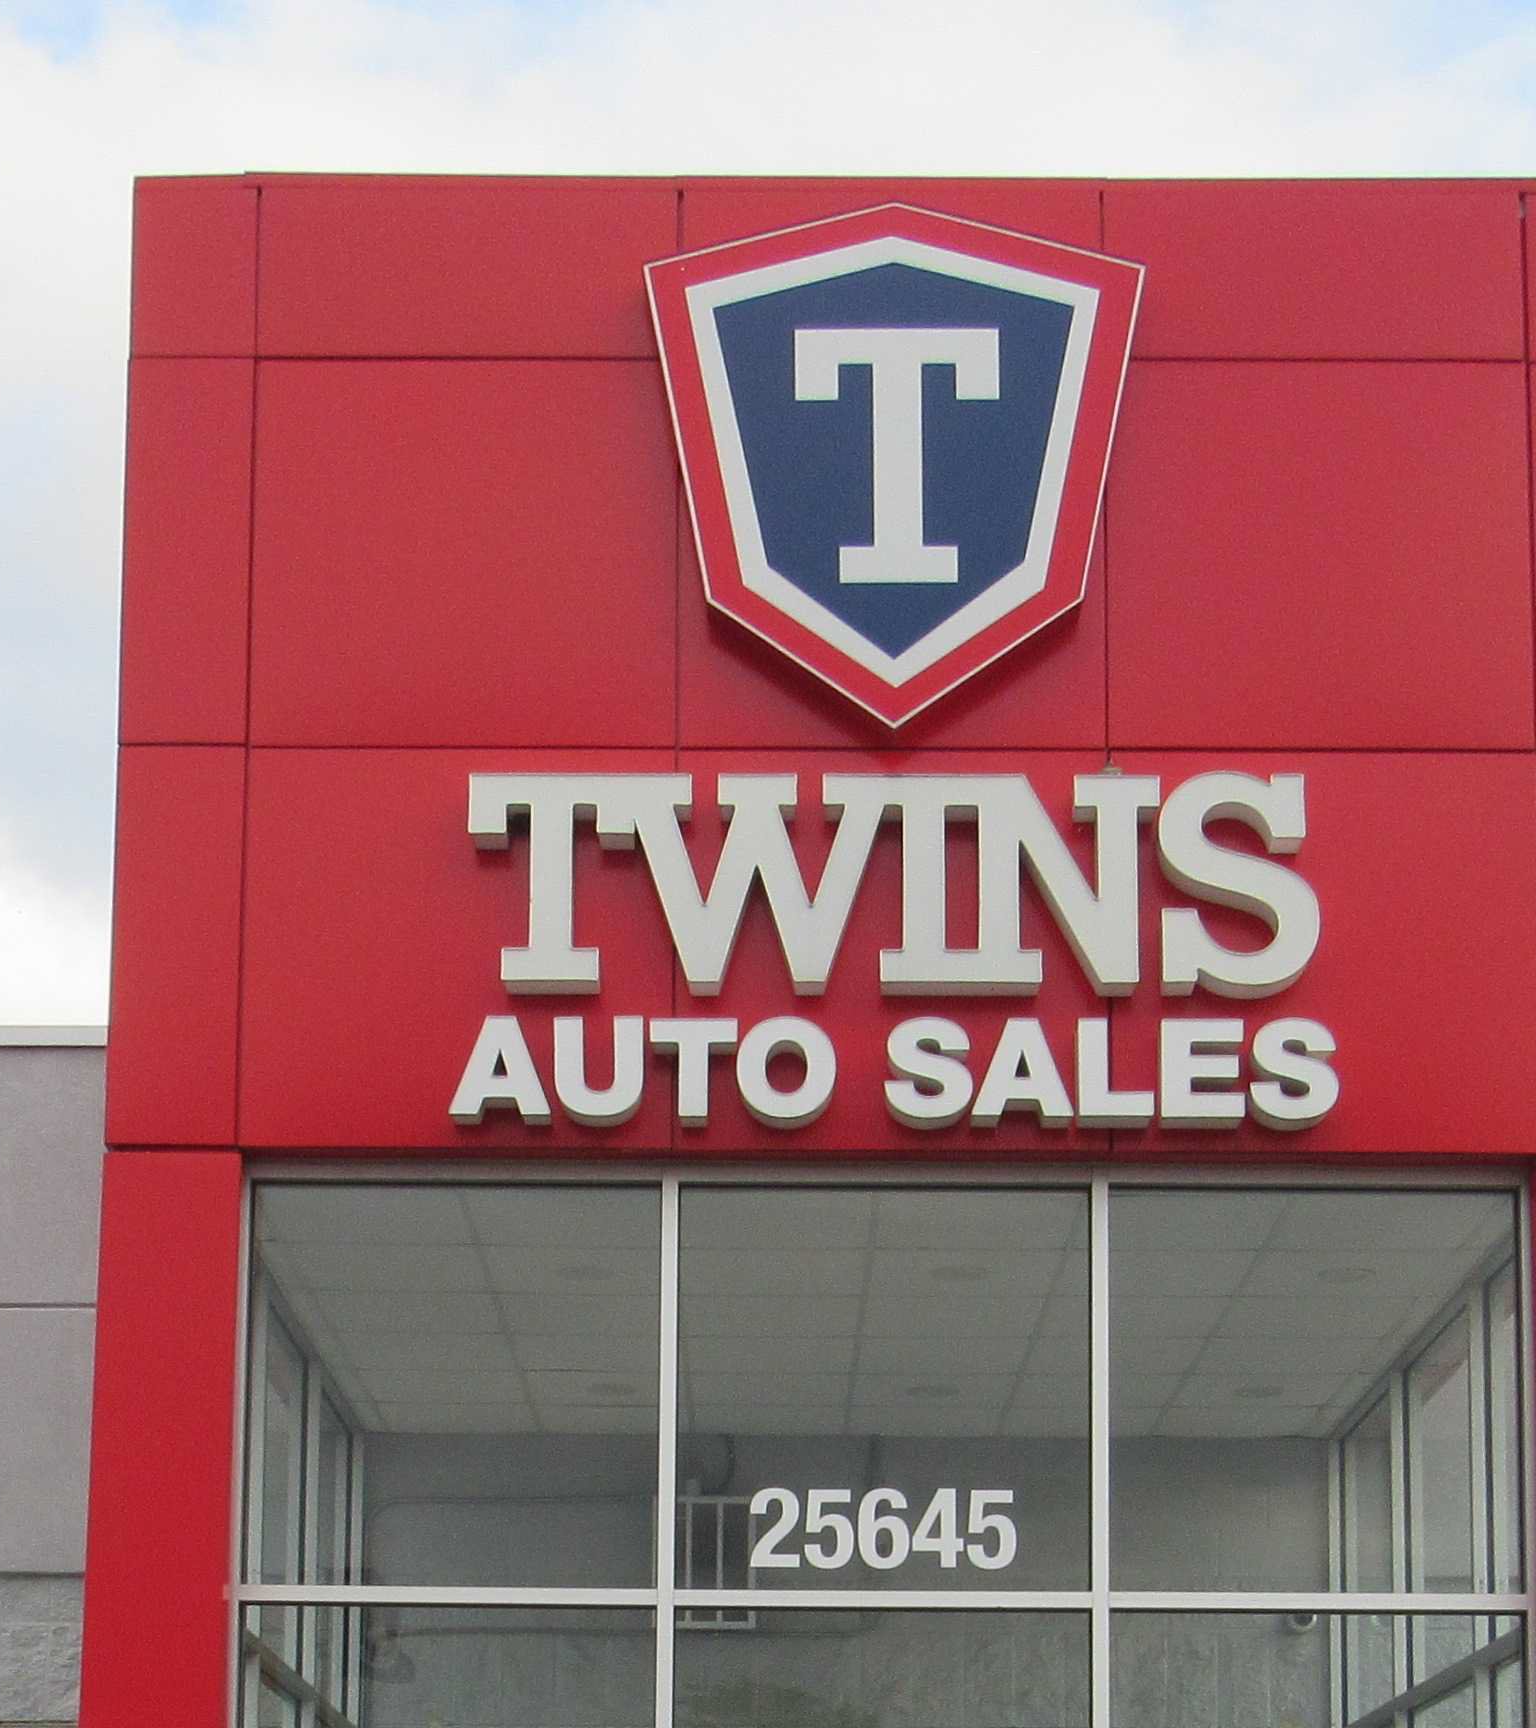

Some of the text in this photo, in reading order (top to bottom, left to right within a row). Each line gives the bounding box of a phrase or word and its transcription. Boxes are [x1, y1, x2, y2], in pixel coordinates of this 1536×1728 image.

[793, 327, 1001, 584] T
[467, 770, 1321, 998] TWINS
[449, 1015, 1340, 1131] AUTO SALES
[749, 1487, 1018, 1569] 25645
